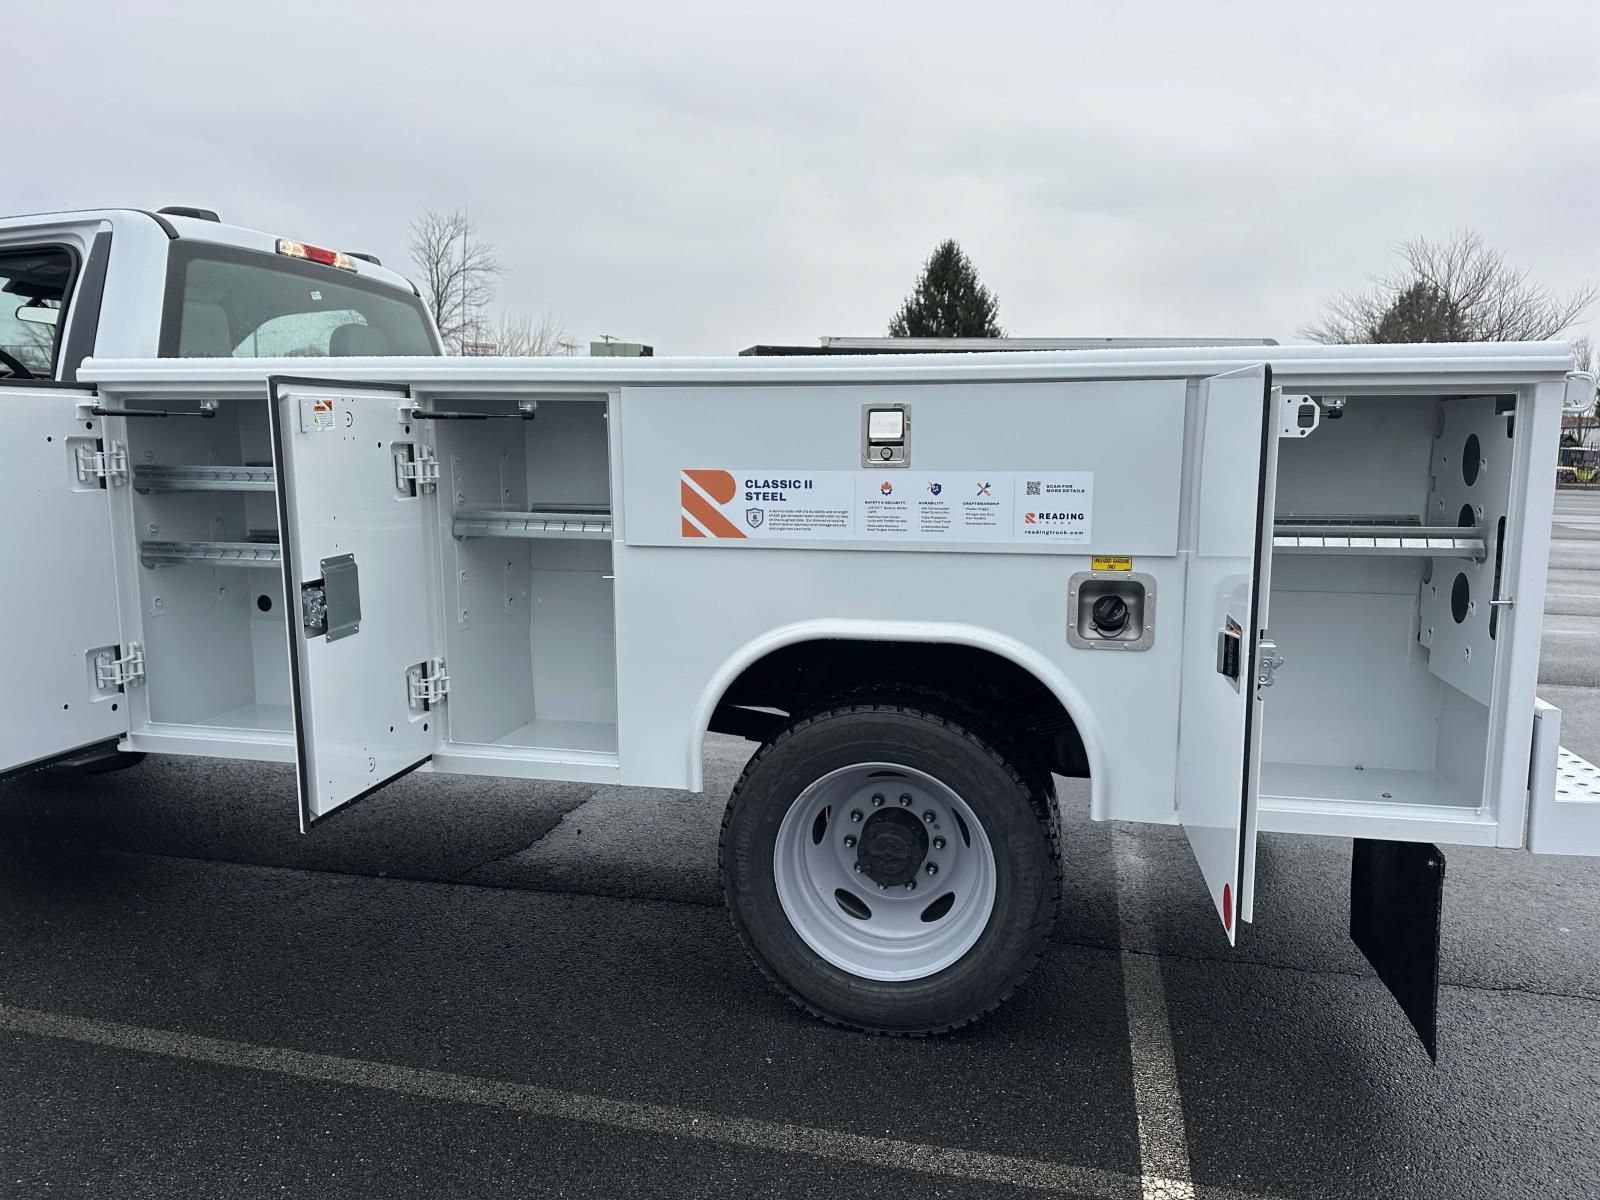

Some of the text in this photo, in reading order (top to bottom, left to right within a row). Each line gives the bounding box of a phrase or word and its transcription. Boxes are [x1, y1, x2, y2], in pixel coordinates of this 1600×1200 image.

[745, 479, 813, 489] CLASSIC II
[745, 492, 786, 501] STEEL
